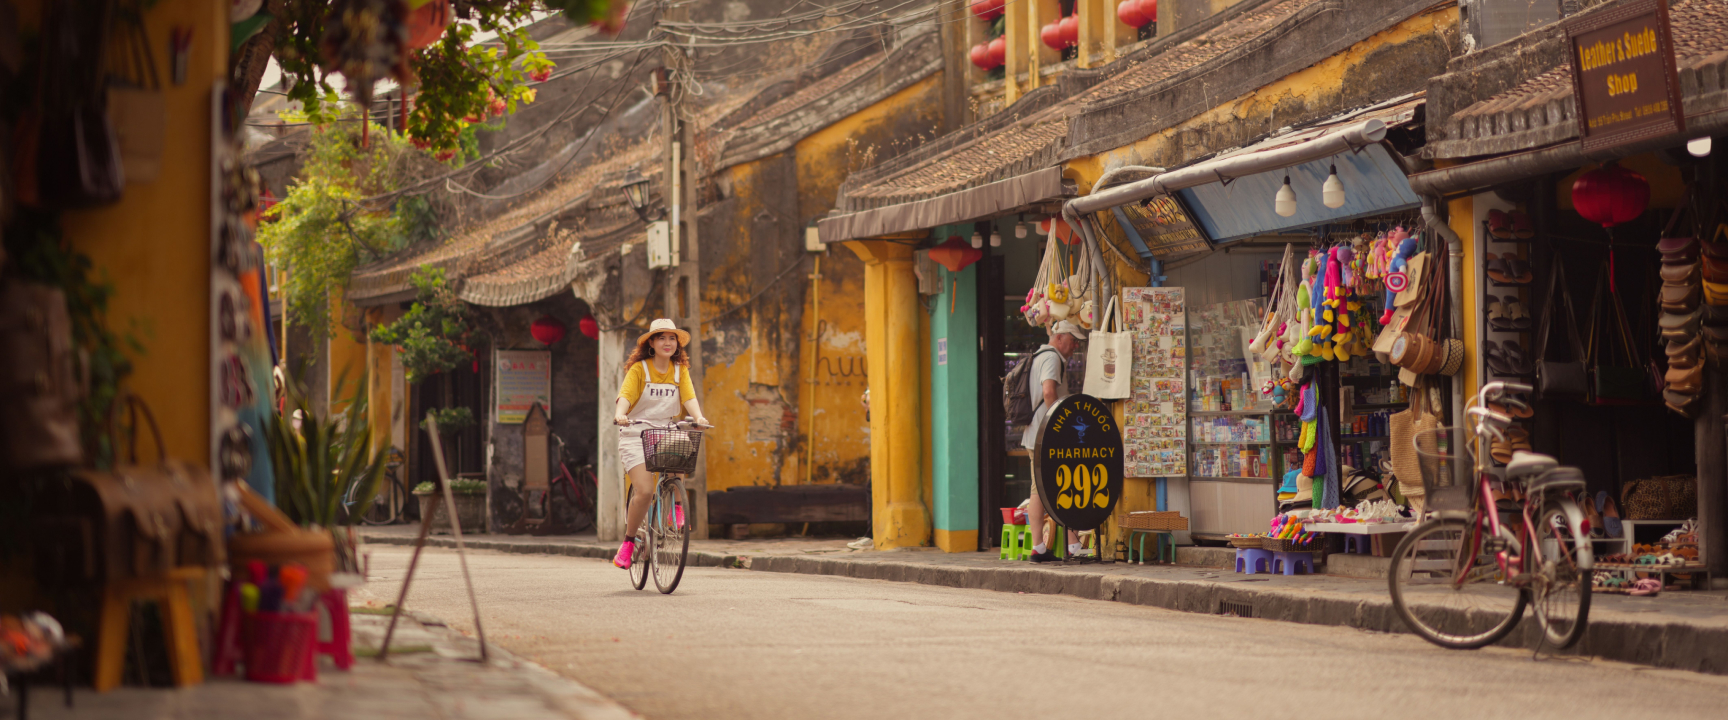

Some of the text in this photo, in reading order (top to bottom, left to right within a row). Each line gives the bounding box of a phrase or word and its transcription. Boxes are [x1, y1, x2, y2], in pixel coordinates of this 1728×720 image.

[1579, 26, 1657, 71] Leather & Suede
[1607, 72, 1638, 96] Shop
[1053, 401, 1111, 432] NHÀ THUỐC
[1049, 447, 1115, 459] PHARMACY
[1056, 463, 1110, 510] 292
